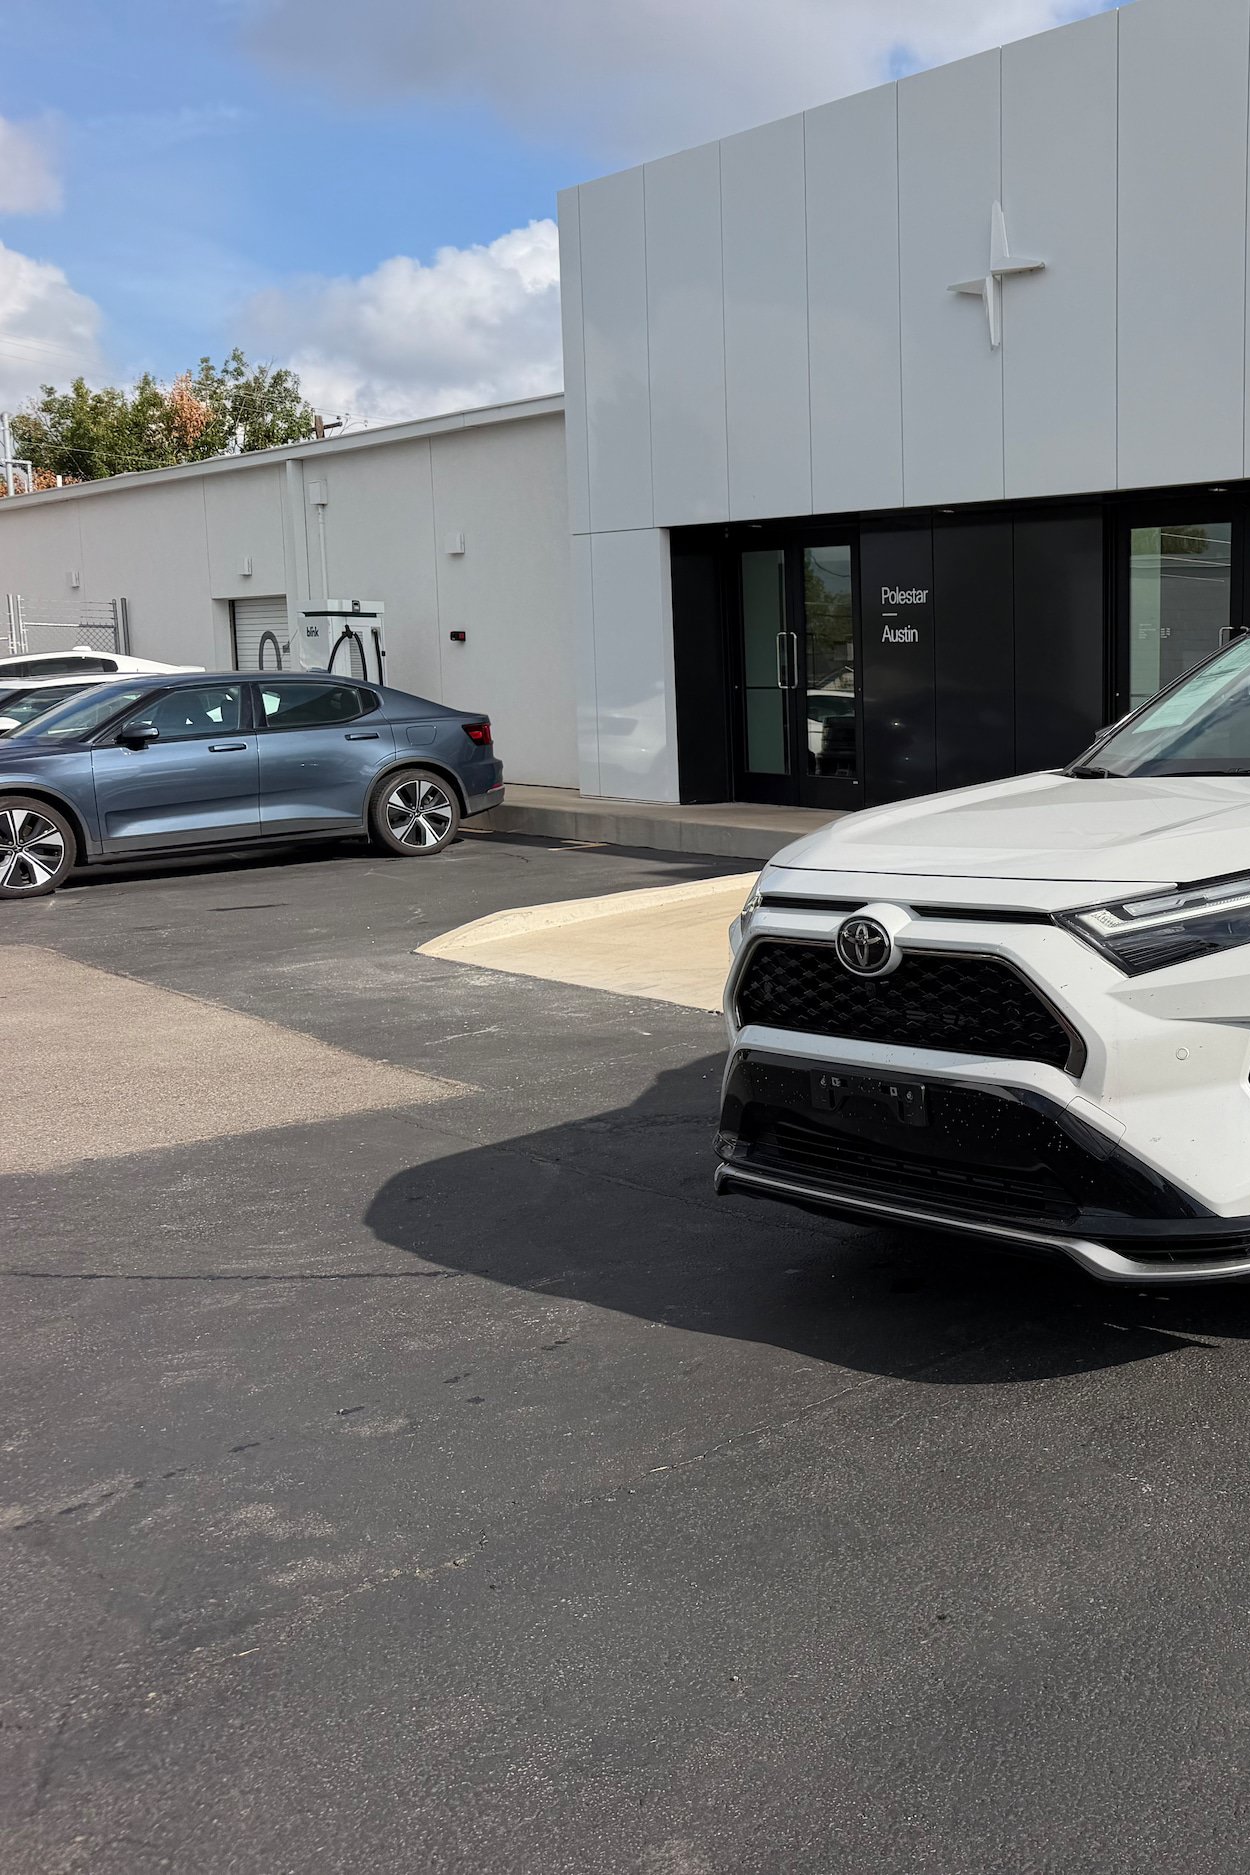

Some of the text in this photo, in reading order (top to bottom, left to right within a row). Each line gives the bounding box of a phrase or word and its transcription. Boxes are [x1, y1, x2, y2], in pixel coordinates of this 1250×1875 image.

[881, 586, 928, 604] Polestar
[307, 627, 319, 637] blink
[881, 625, 918, 642] Austin
